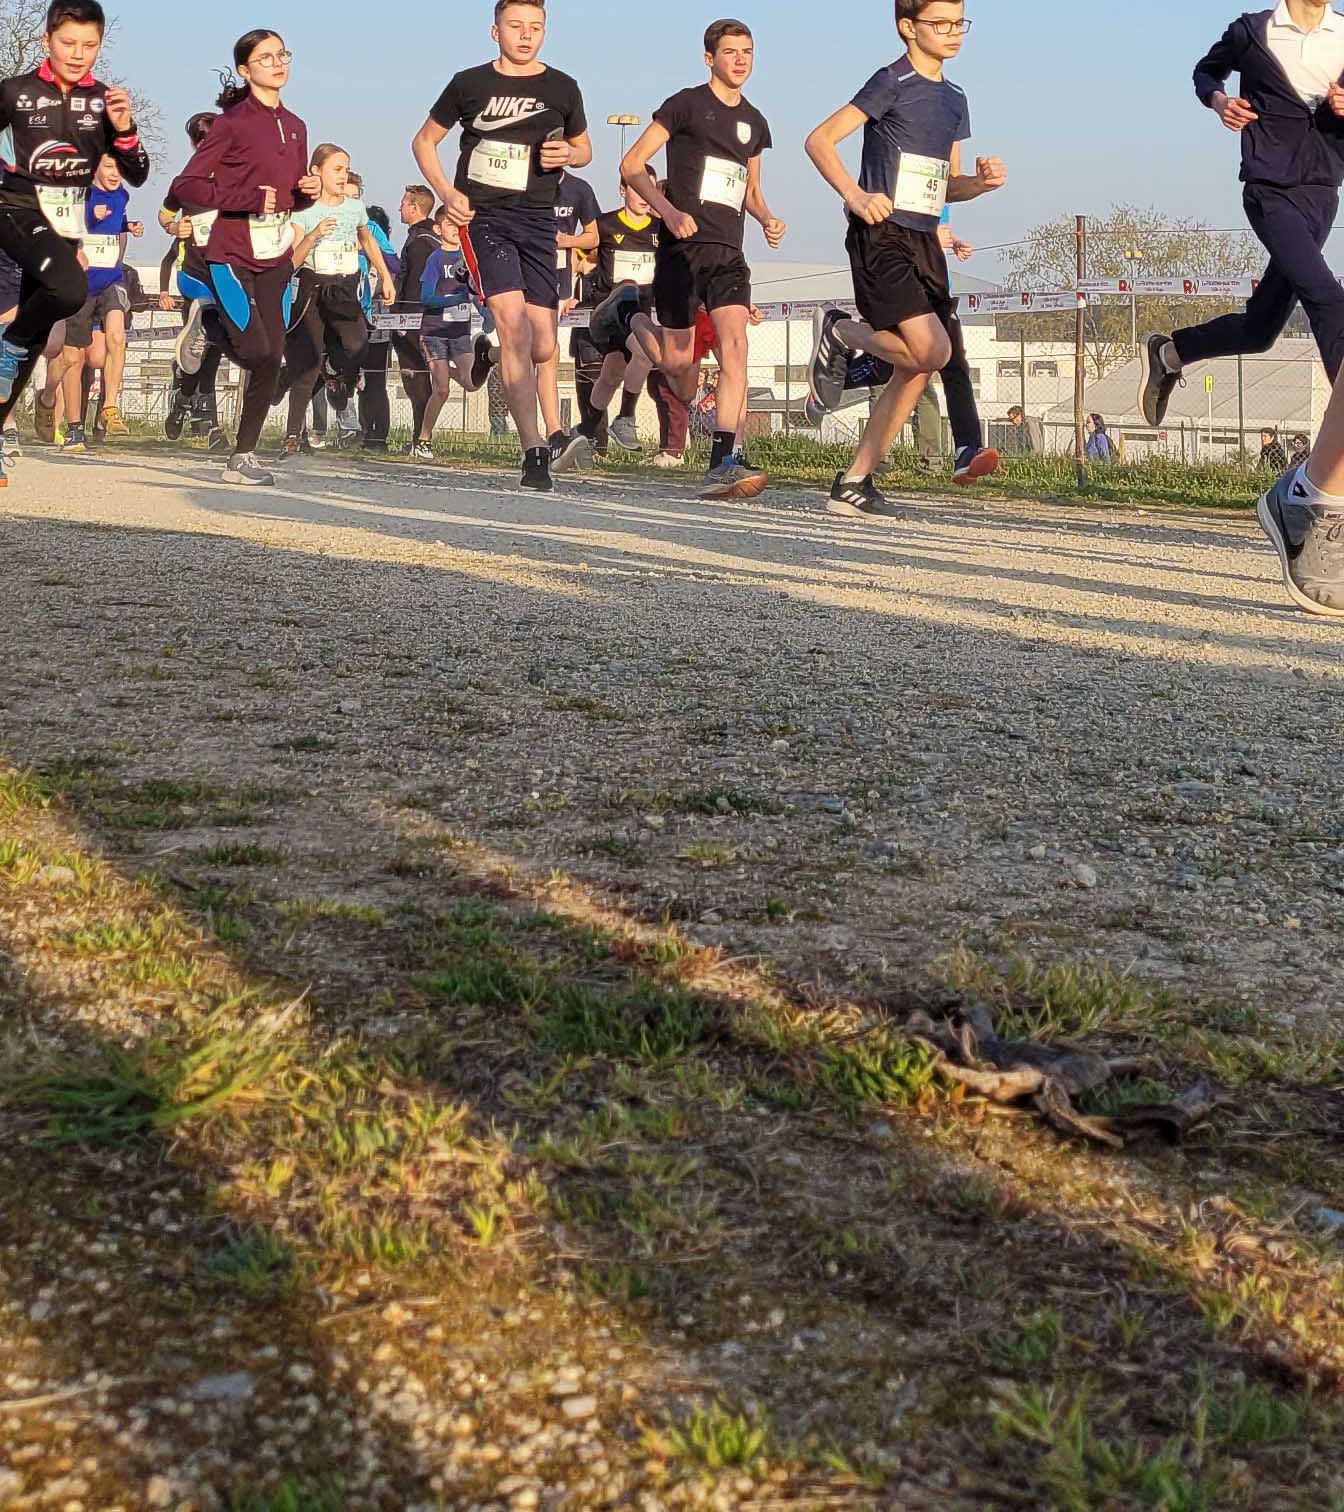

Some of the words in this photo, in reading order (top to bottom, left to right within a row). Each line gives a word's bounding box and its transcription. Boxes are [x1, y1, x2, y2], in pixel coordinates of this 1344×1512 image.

[488, 157, 508, 170] 103
[926, 178, 939, 192] 45
[55, 206, 71, 217] 81
[95, 246, 105, 254] 74
